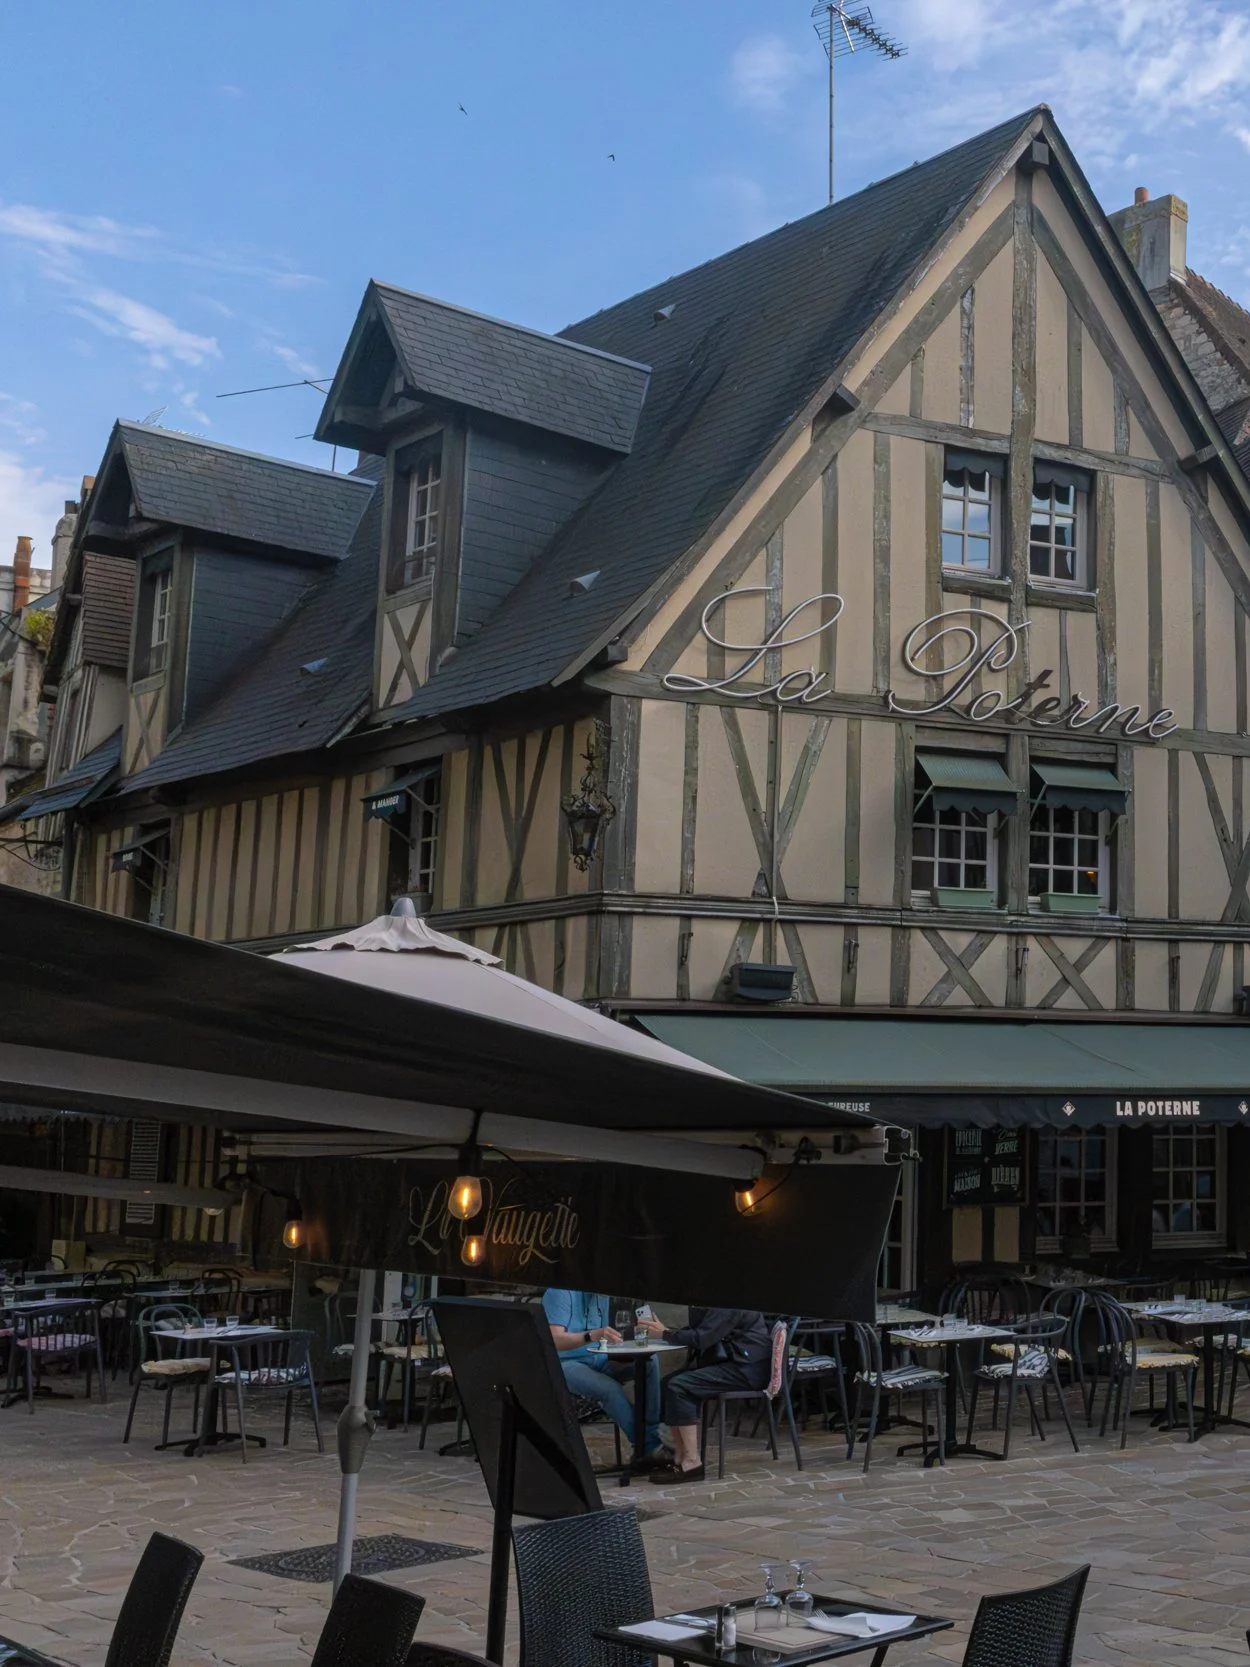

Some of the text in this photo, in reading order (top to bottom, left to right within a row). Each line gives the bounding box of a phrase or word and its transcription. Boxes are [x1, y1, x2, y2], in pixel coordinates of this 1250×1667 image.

[663, 586, 1180, 738] La Poterne
[1116, 1101, 1200, 1116] LA POTERNE
